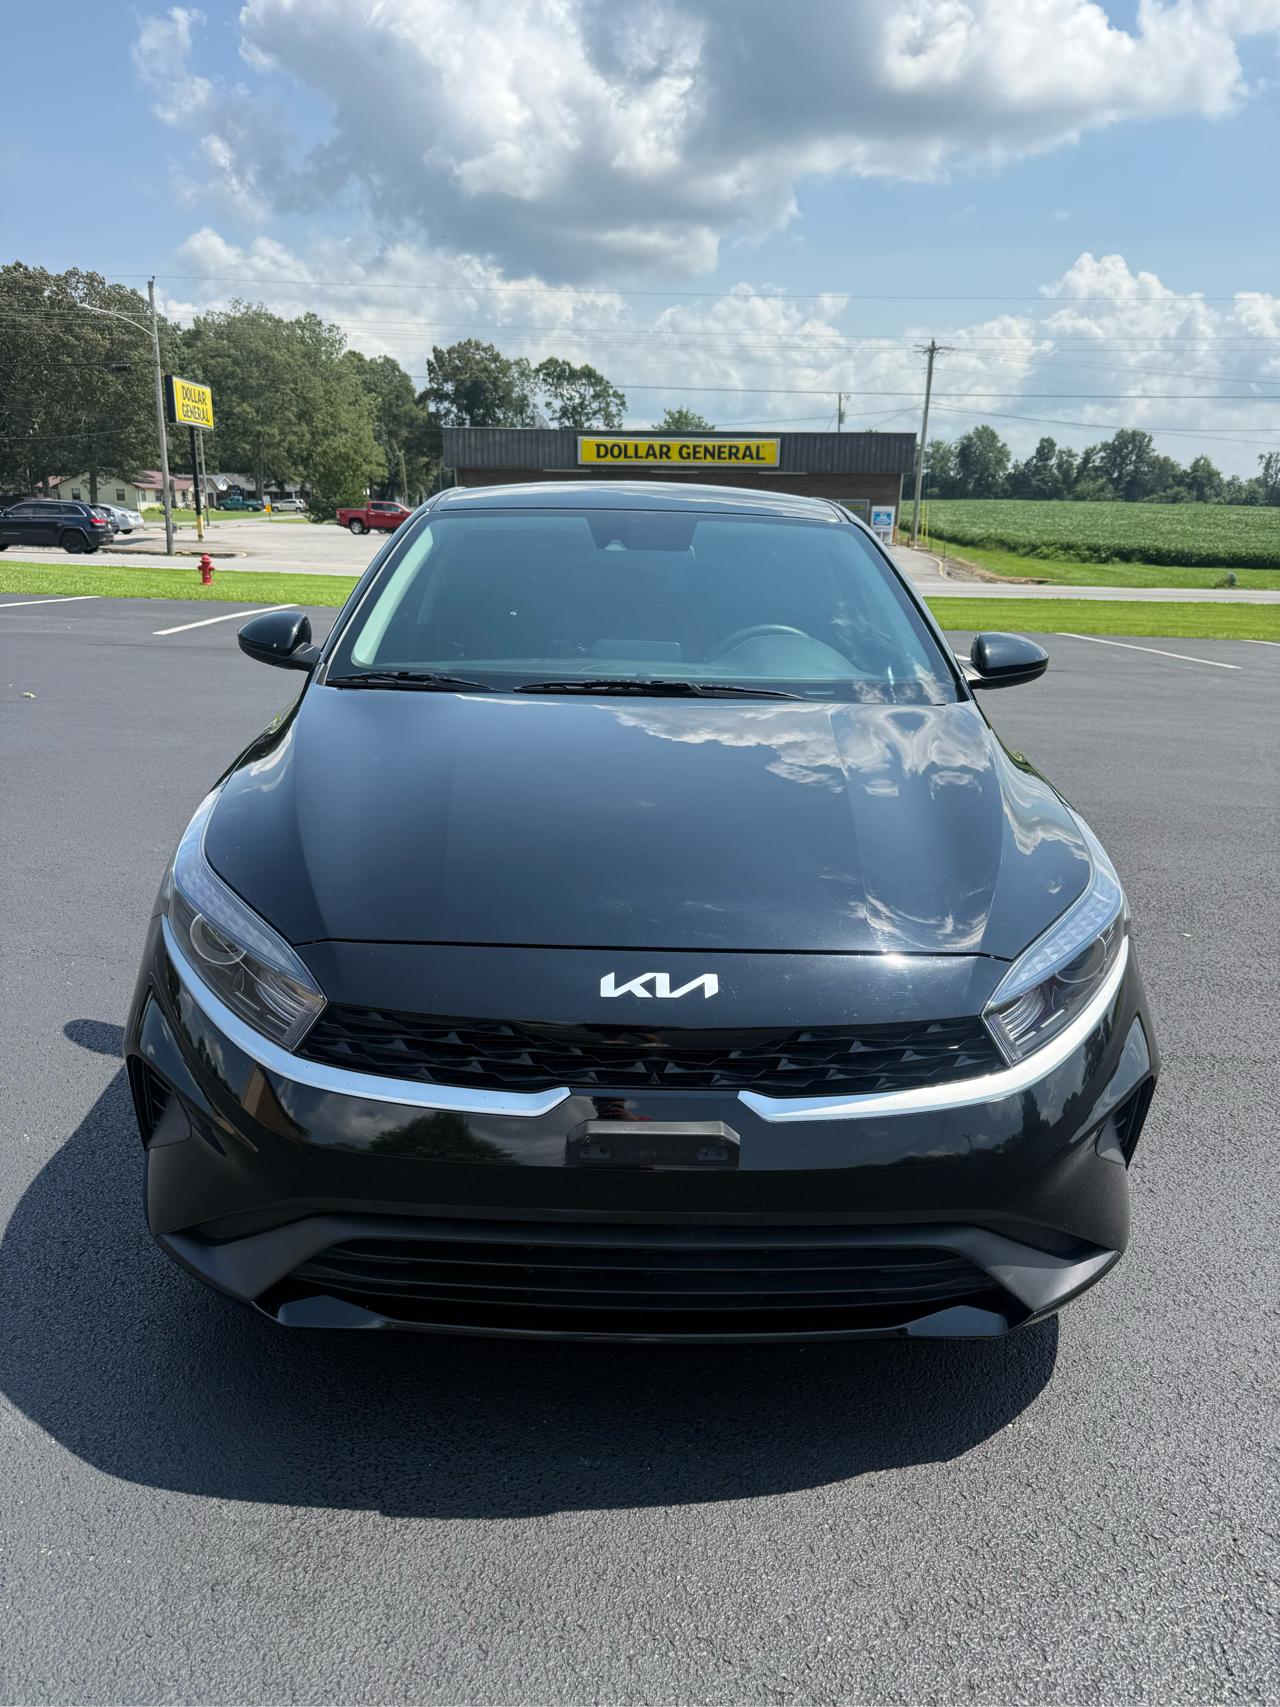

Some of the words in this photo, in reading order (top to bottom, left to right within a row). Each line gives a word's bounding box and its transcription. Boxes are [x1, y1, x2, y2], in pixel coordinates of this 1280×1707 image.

[182, 385, 207, 406] DOLLAR
[182, 402, 210, 423] GENERAL
[595, 443, 671, 459] DOLLAR
[678, 444, 765, 460] GENERAL
[600, 972, 718, 998] KIA
